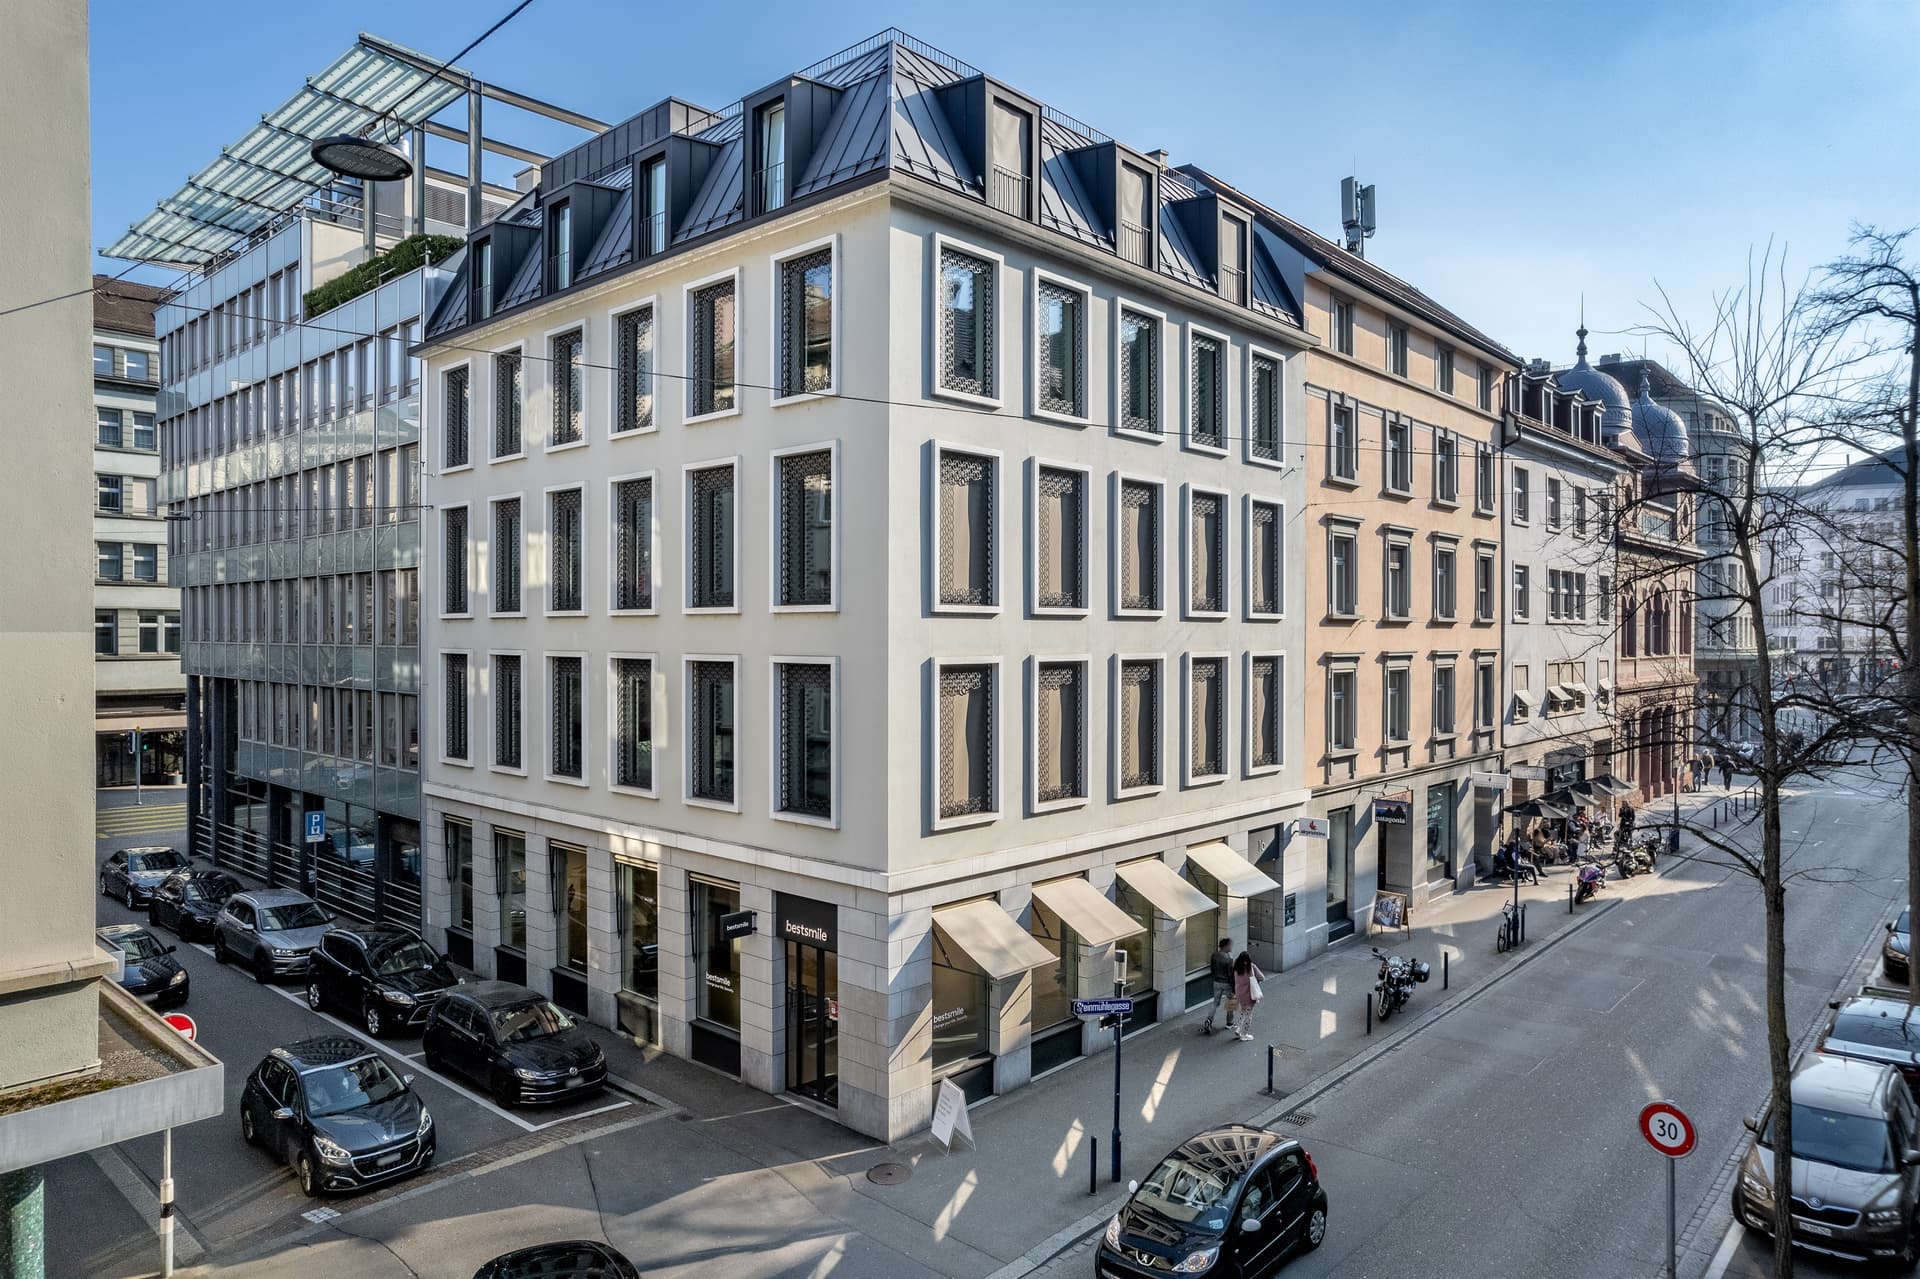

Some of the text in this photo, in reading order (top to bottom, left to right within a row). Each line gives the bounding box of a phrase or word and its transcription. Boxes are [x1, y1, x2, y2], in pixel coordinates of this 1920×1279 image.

[312, 814, 320, 826] P
[726, 921, 749, 931] bestsmile
[785, 919, 828, 942] bestsmile
[705, 970, 731, 987] bestsmile
[933, 1007, 965, 1024] bestsmile
[1657, 1118, 1678, 1141] 30
